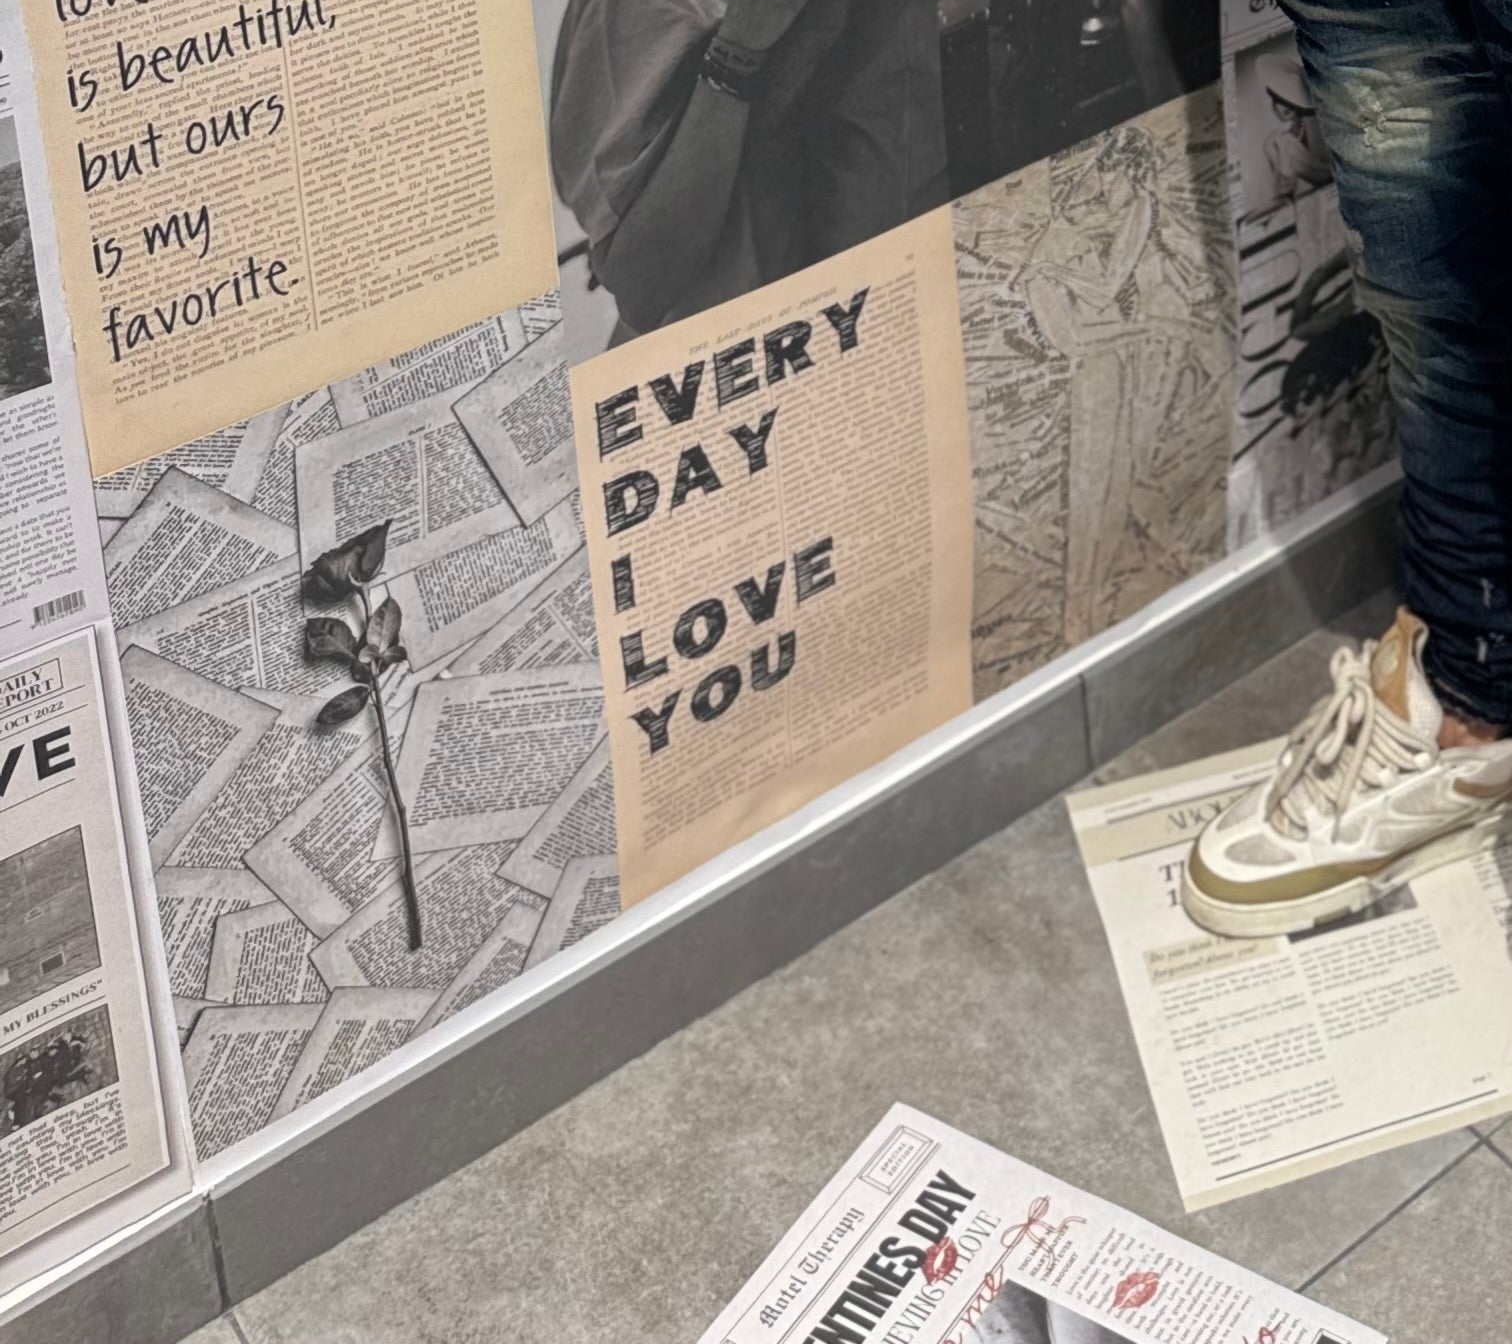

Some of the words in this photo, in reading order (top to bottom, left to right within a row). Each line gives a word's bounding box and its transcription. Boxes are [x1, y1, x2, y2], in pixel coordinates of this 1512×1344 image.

[66, 64, 99, 110] is
[77, 127, 162, 194] but
[184, 95, 287, 156] ours
[93, 229, 123, 277] is
[140, 202, 213, 261] my
[102, 259, 303, 364] favorite.
[593, 286, 871, 464] EVERY
[602, 408, 780, 538] DAY
[611, 553, 634, 614] I
[621, 536, 839, 693] LOVE
[628, 631, 798, 758] YOU
[897, 1168, 977, 1245] DAY
[759, 1273, 808, 1328] Motel
[798, 1208, 865, 1275] Therapy
